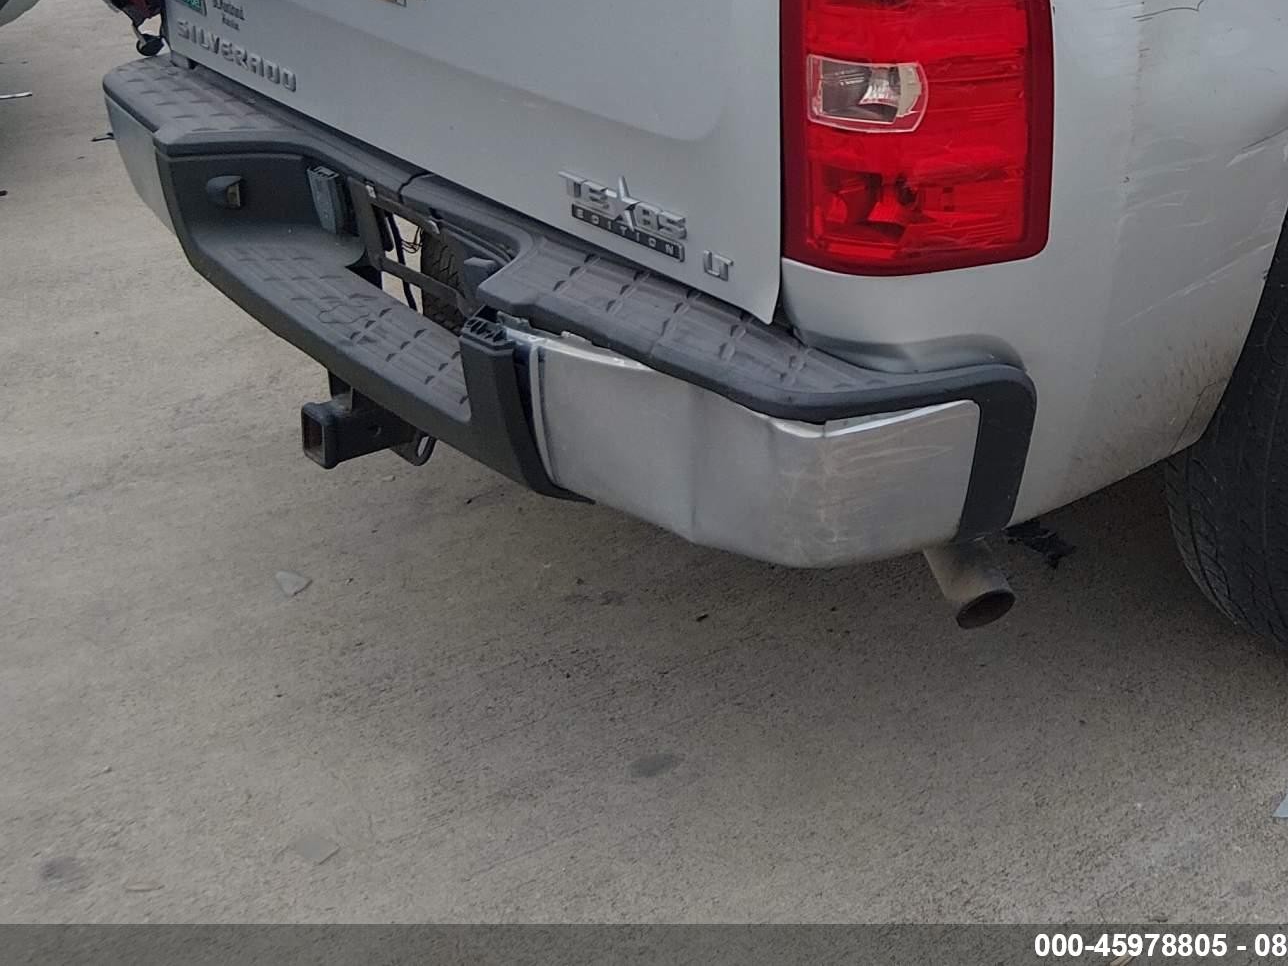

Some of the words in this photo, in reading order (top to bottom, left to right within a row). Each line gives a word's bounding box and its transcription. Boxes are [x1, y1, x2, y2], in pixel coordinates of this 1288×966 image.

[177, 19, 297, 93] SILVERADO
[558, 170, 688, 240] TEXAS
[574, 206, 677, 256] EDITION
[703, 249, 734, 282] LT
